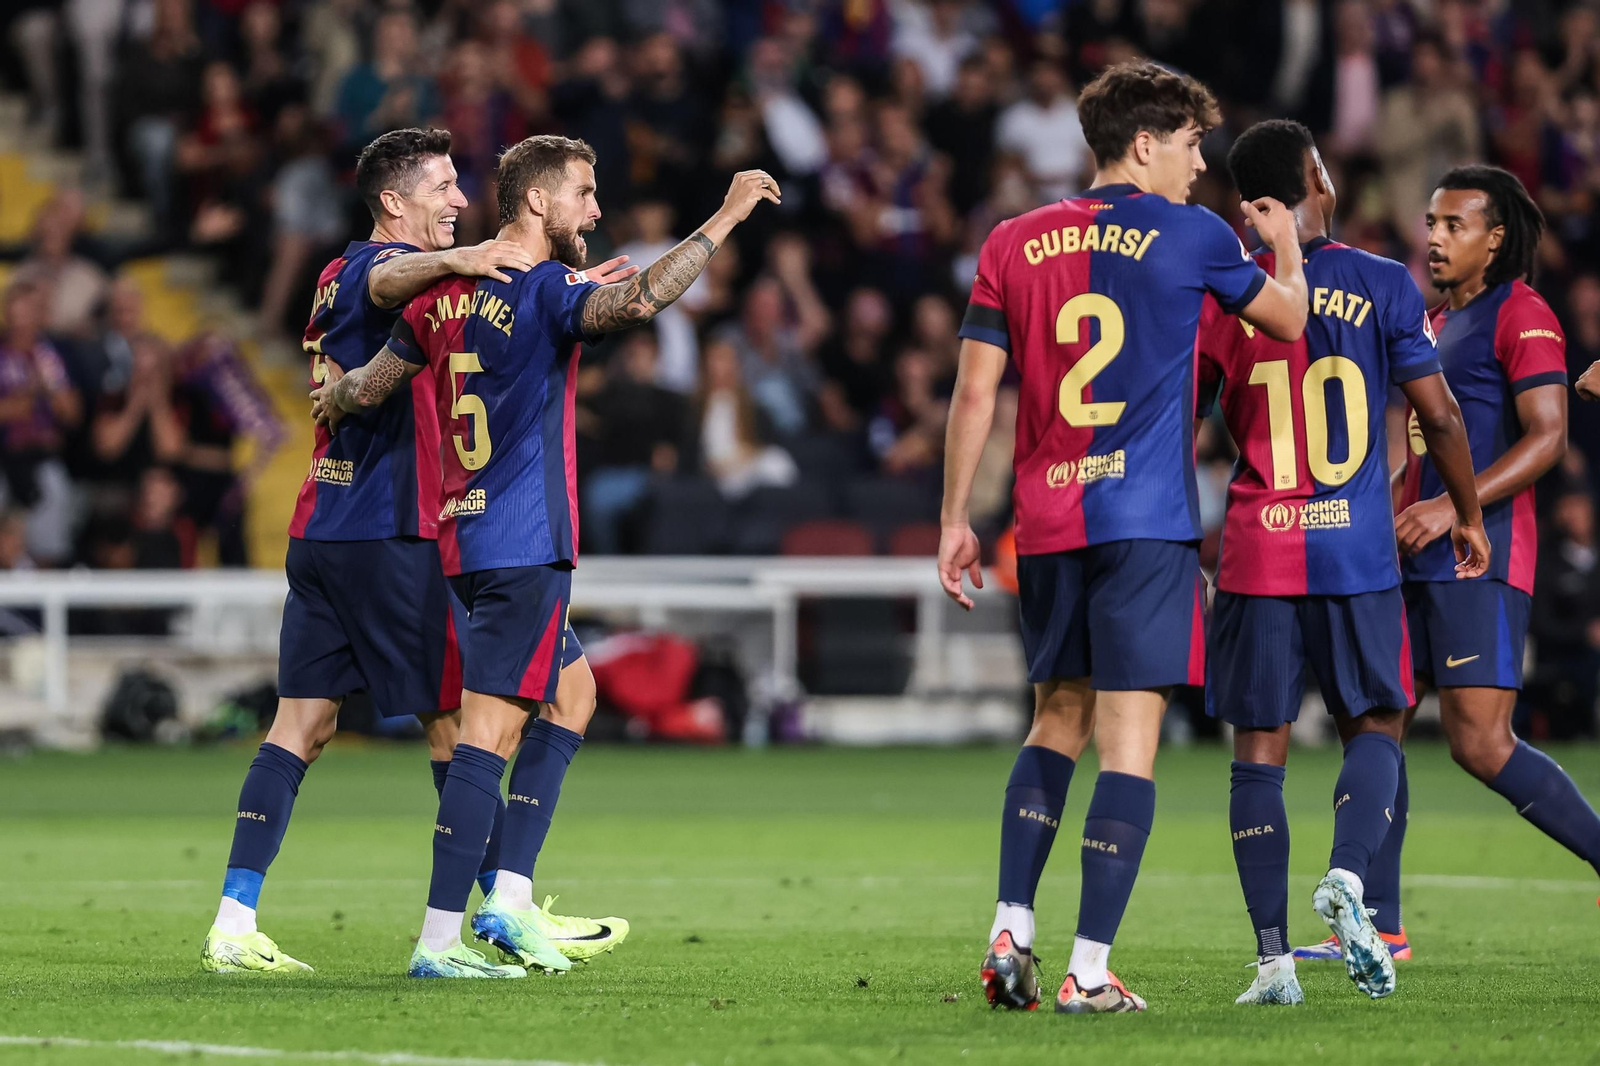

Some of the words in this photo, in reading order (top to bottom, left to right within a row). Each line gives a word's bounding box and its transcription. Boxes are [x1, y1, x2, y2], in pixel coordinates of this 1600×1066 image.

[1023, 224, 1160, 266] CUBARSÍ
[1313, 287, 1372, 328] FATI
[1055, 293, 1127, 428] 2
[448, 352, 492, 471] 5
[1247, 355, 1369, 491] 10
[318, 457, 354, 471] UNHCR
[1077, 449, 1125, 468] UNHCR
[314, 467, 354, 482] ACNUR
[1076, 460, 1125, 479] ACNUR
[455, 499, 486, 511] CNUR
[1298, 499, 1349, 514] UNHCR
[1298, 510, 1350, 525] ACNUR
[1018, 808, 1059, 828] BARÇA
[434, 823, 452, 835] RÇA
[1082, 837, 1118, 855] ARÇA
